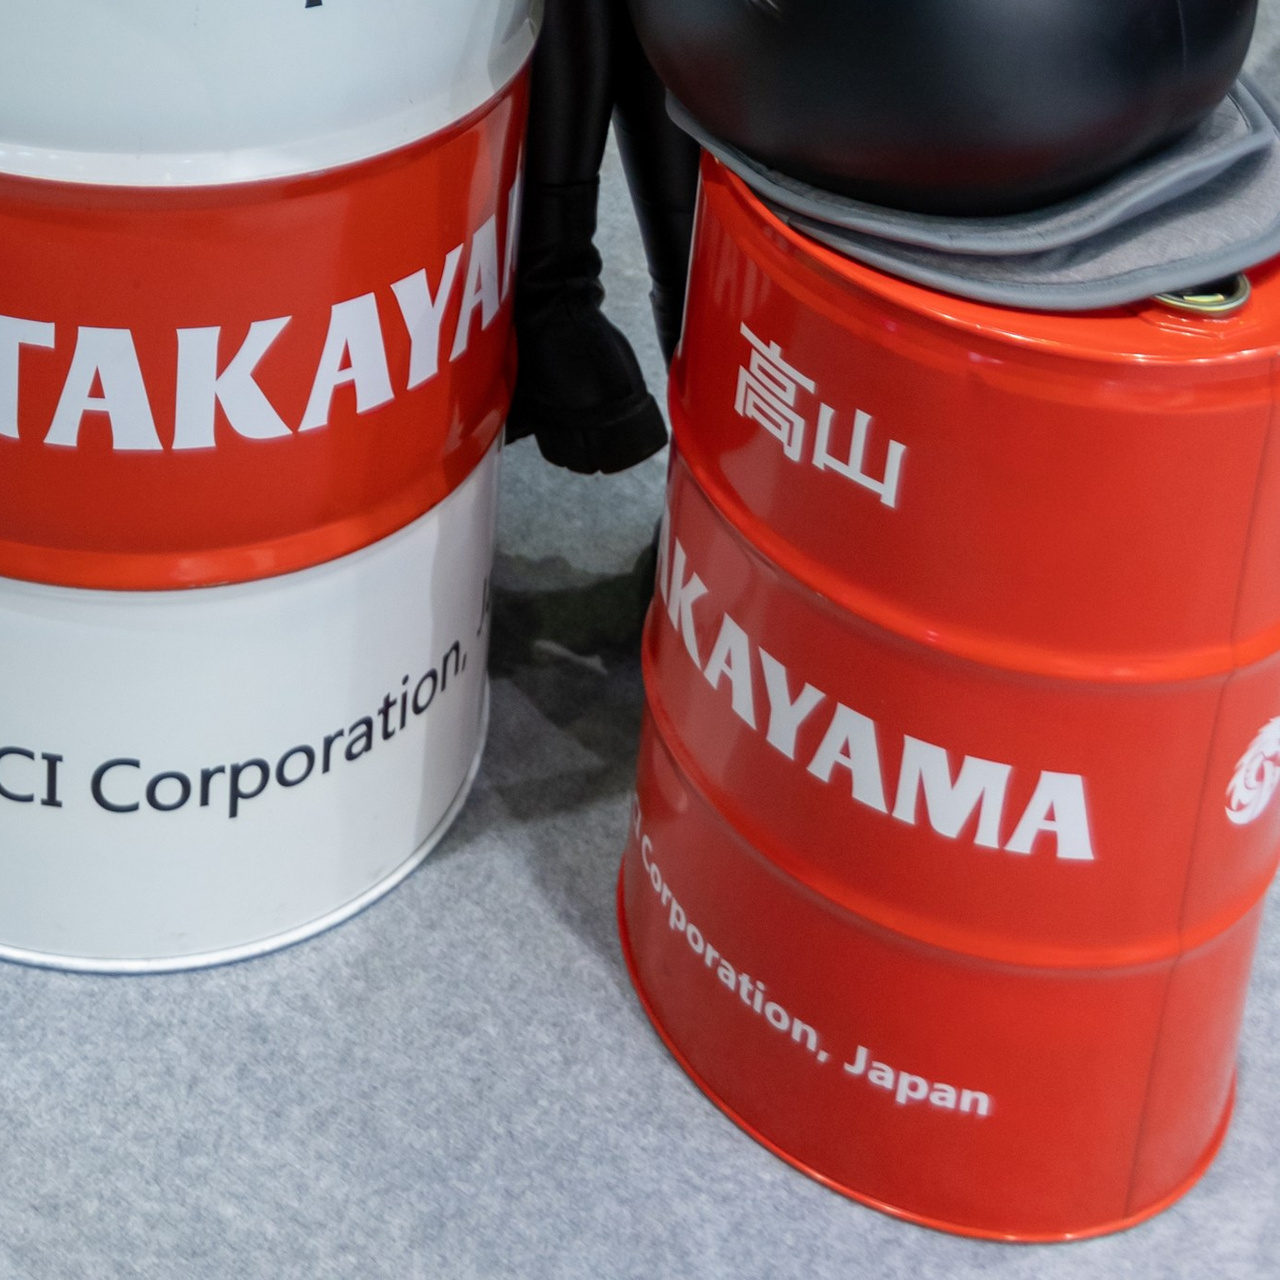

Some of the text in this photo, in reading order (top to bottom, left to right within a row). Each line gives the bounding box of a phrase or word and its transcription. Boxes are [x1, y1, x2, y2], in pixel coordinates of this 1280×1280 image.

[732, 322, 907, 508] 高山
[90, 637, 469, 819] Corporation,
[640, 836, 993, 1117] Corporation, Japan
